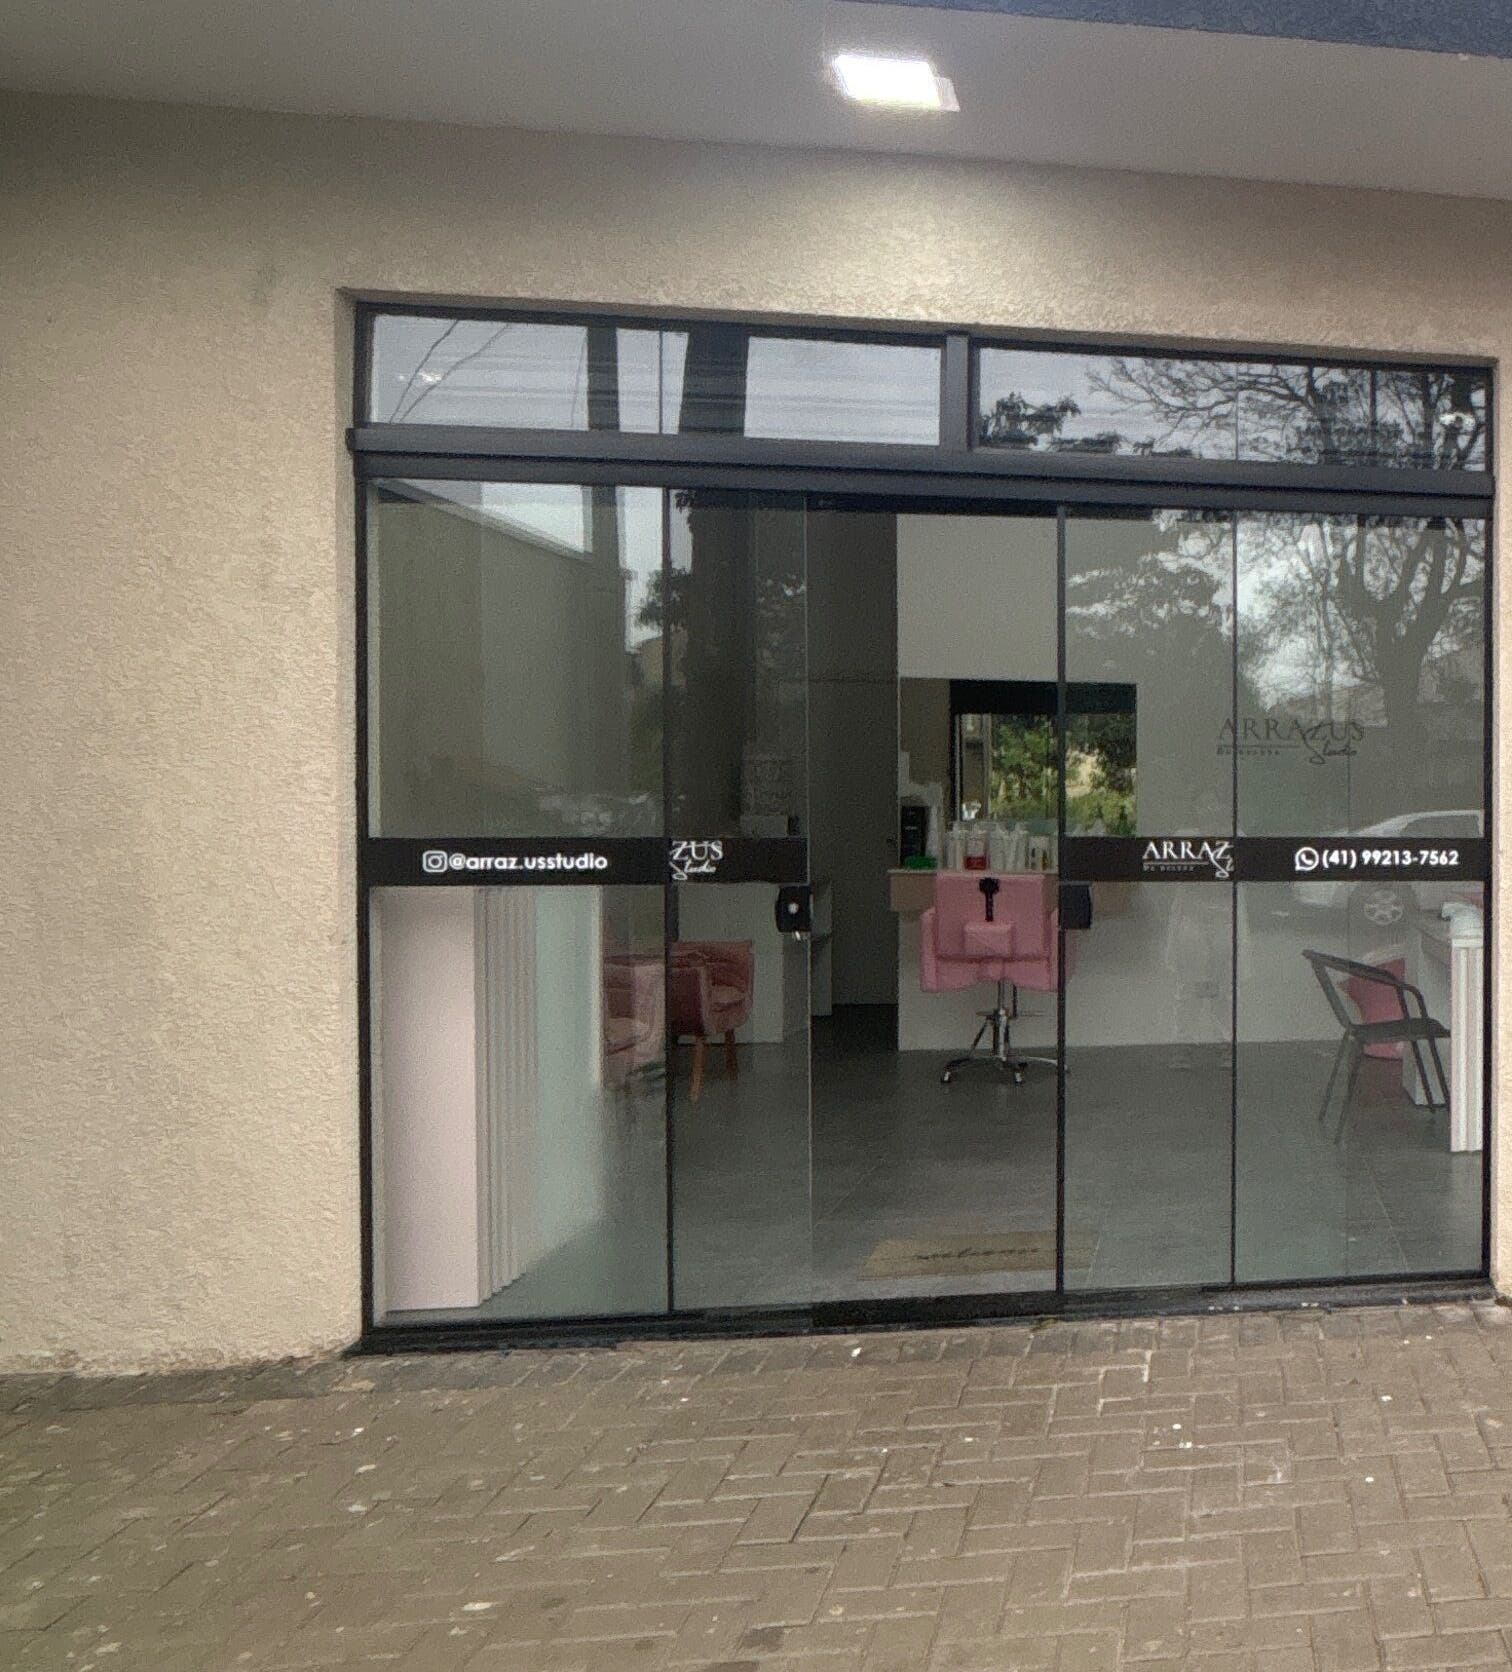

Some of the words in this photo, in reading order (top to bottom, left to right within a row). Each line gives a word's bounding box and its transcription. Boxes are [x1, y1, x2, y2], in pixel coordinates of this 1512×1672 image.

[449, 852, 608, 870] @arraz.usstudio
[1322, 849, 1357, 869] (41)
[1361, 849, 1459, 866] 99213-7562
